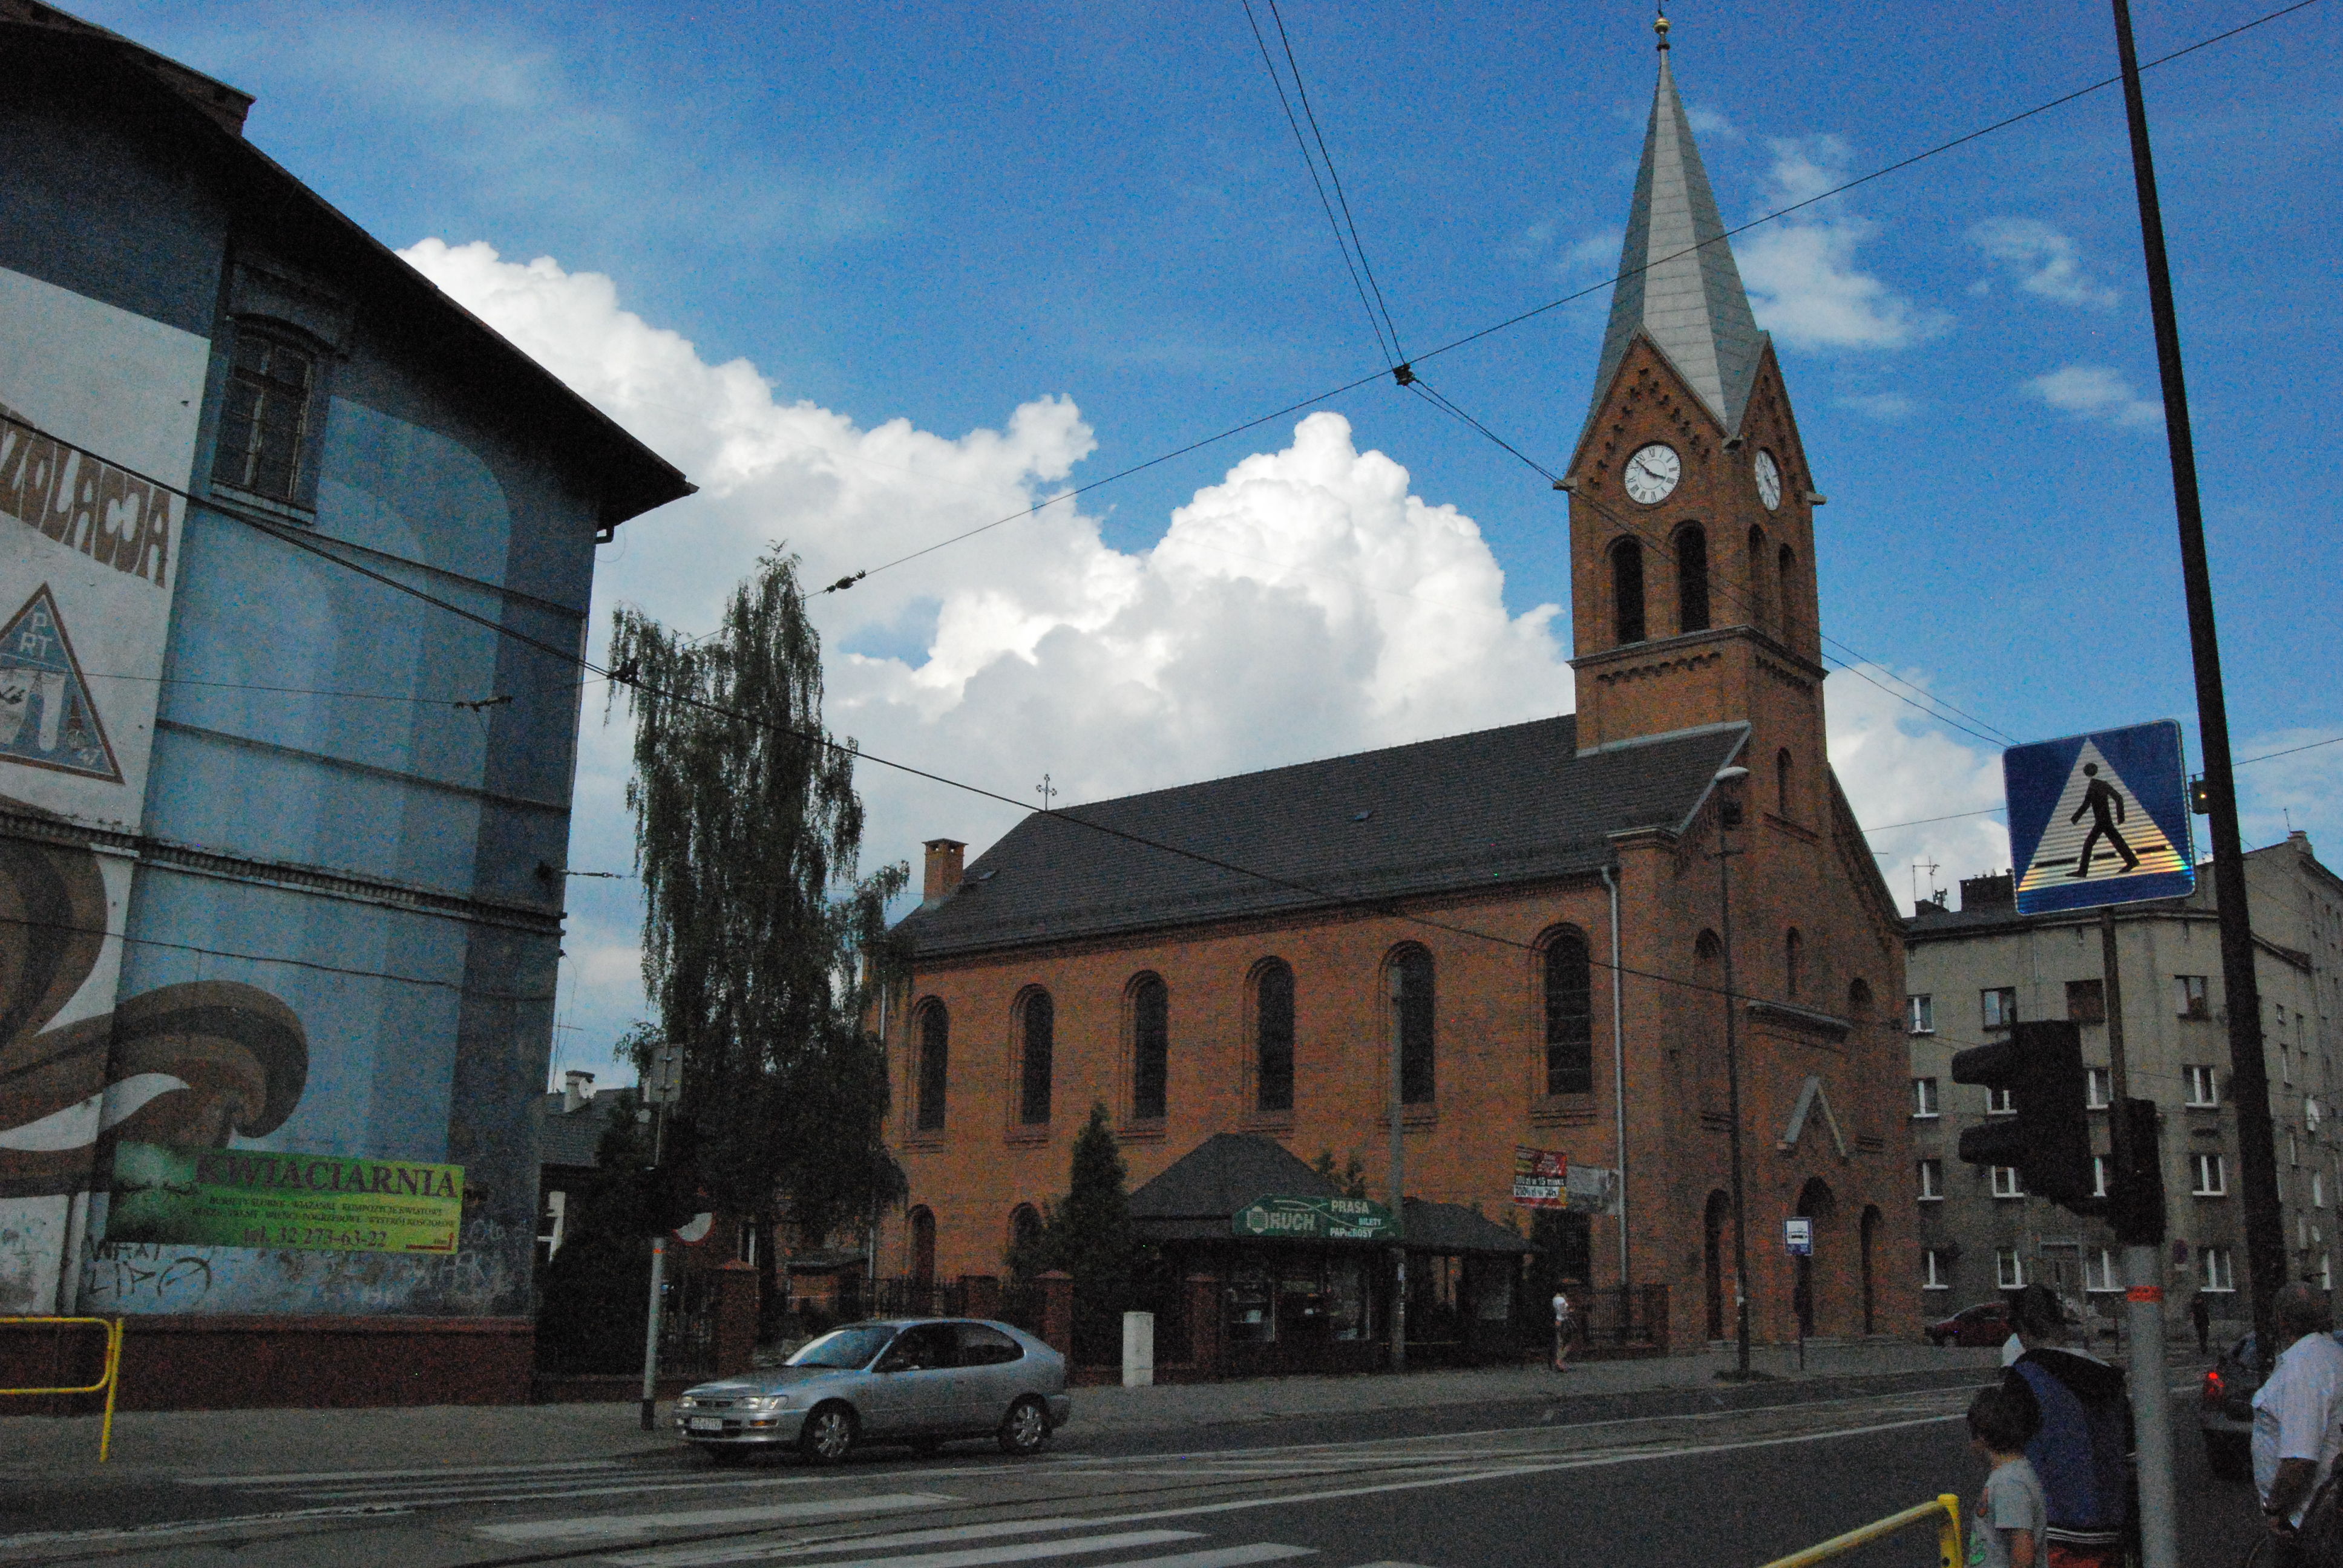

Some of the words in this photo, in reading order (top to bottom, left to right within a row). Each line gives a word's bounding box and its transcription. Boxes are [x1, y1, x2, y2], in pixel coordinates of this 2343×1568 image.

[195, 1154, 459, 1198] KWIACIARNIA
[1331, 1199, 1369, 1214] PRASA
[1270, 1212, 1316, 1232] RUCH
[1358, 1218, 1381, 1226] BILETY
[1330, 1227, 1373, 1238] PAPIEROSY
